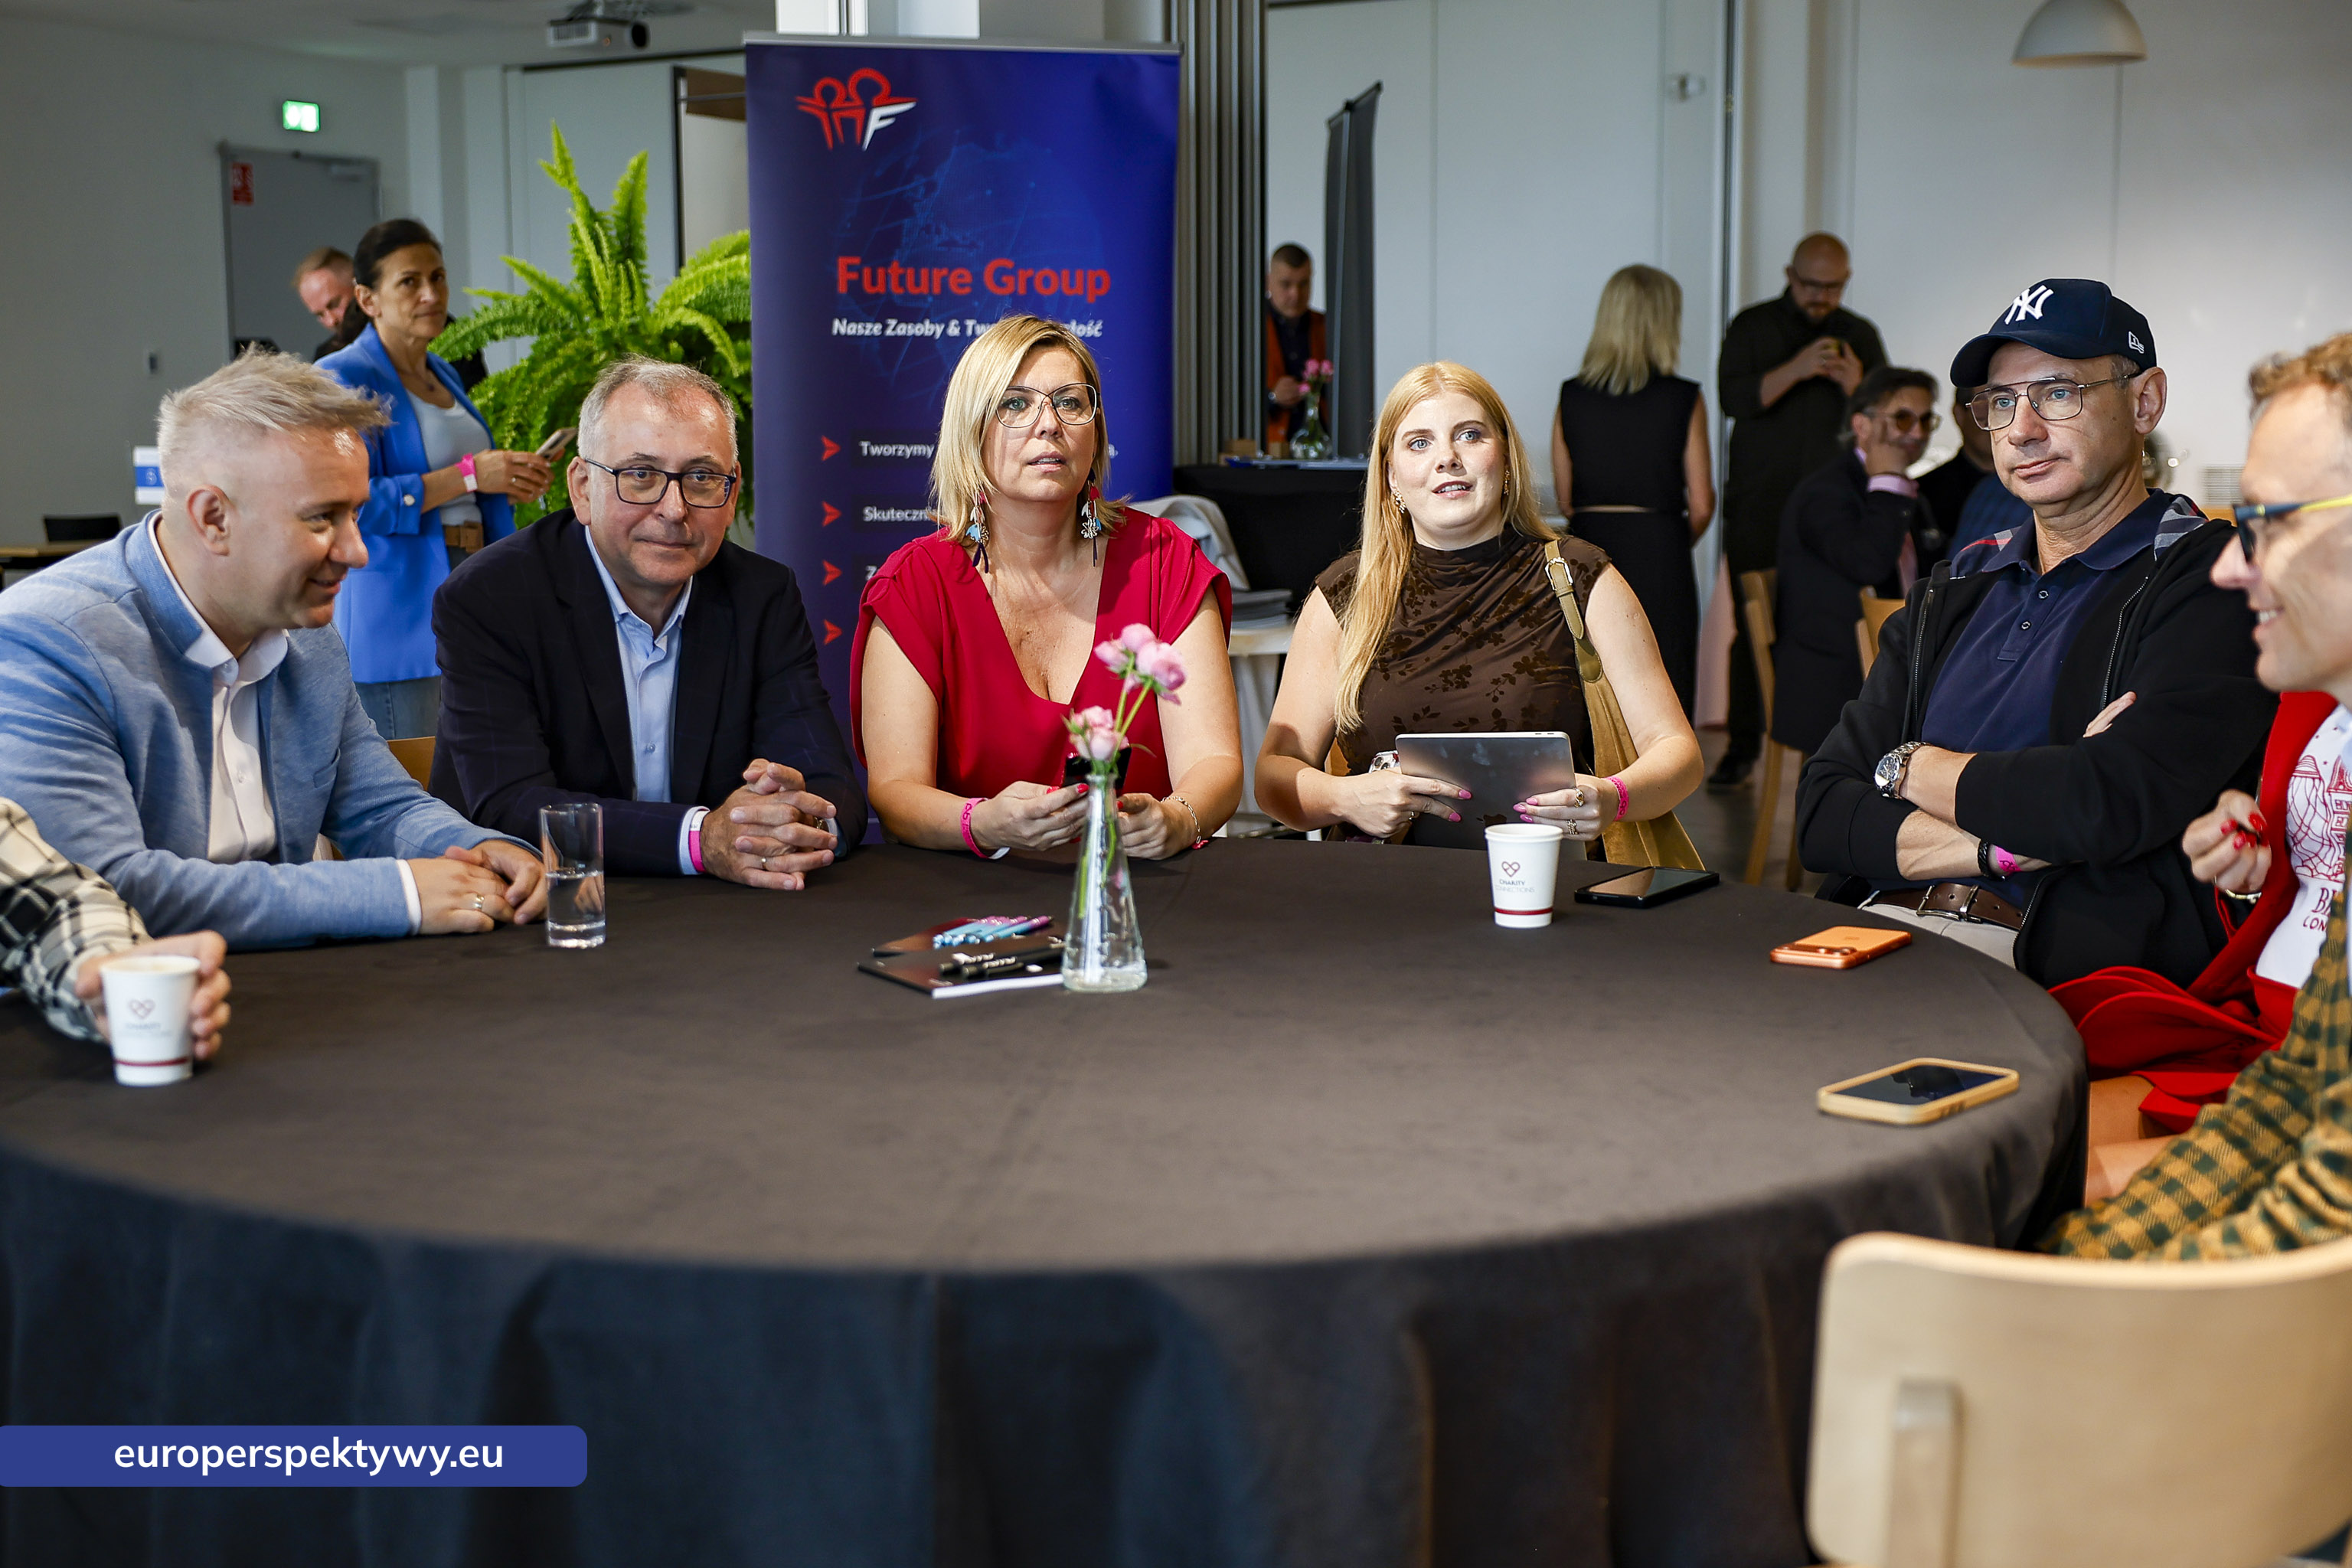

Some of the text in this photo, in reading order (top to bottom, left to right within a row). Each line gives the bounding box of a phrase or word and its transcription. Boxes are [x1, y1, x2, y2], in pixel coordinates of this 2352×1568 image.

[837, 256, 1112, 304] Future Group
[2004, 284, 2055, 325] NY
[831, 318, 883, 336] Nasze
[885, 318, 946, 339] Zasoby
[946, 318, 961, 337] &
[858, 440, 935, 459] Tworzymy
[862, 505, 932, 522] Skuteczn
